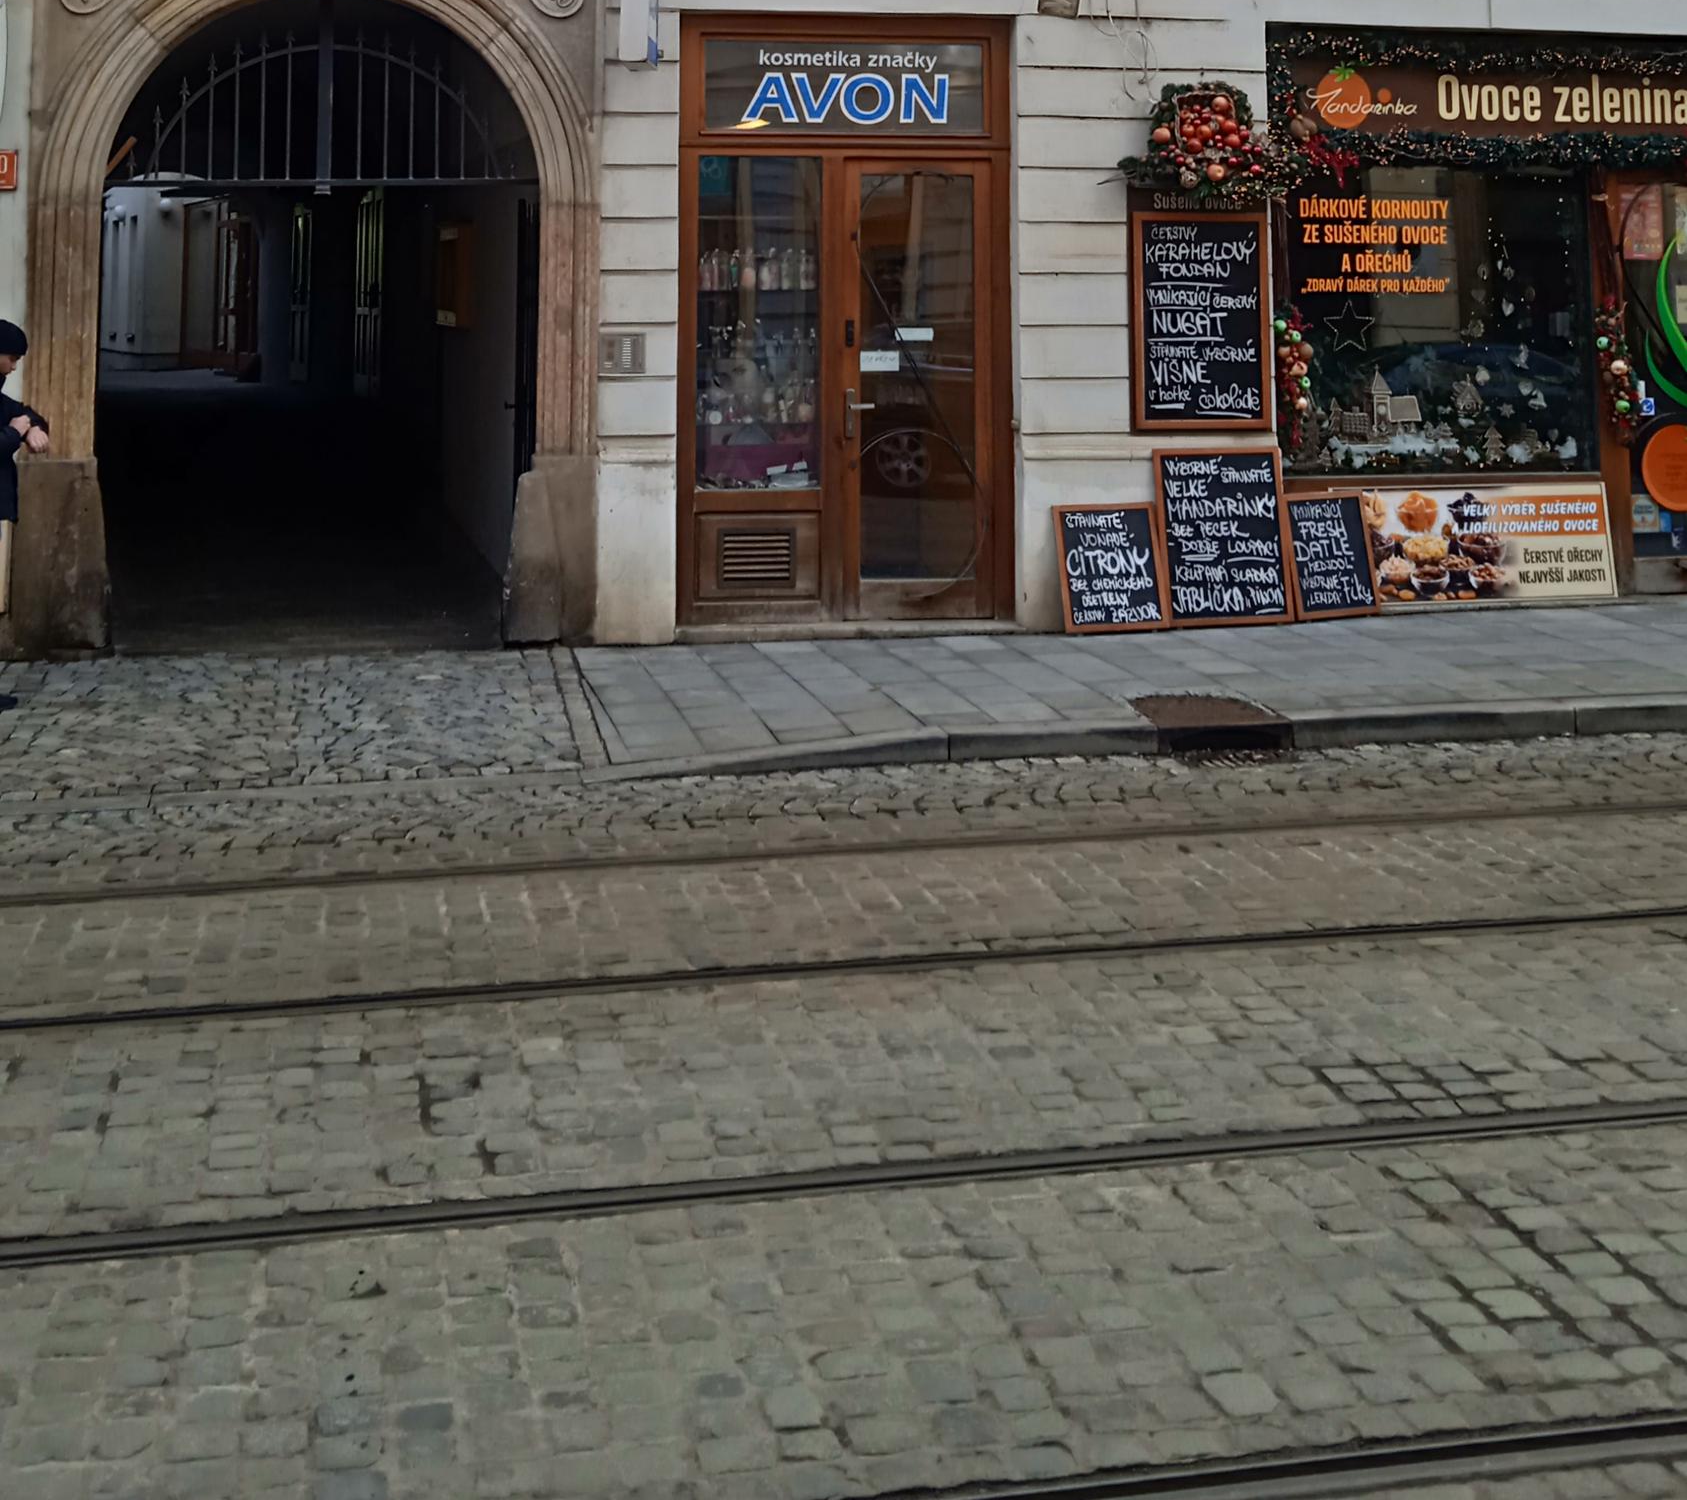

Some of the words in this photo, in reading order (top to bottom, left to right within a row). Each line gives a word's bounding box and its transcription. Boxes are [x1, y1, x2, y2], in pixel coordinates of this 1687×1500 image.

[758, 49, 861, 68] kosmetika
[867, 51, 938, 72] značky
[741, 72, 949, 125] AVON
[1437, 74, 1541, 122] Ovoce
[1553, 74, 1687, 125] zelenina
[1300, 194, 1367, 218] DÁRKOVÉ
[1371, 198, 1449, 220] KORNOUTY
[1303, 224, 1320, 244] ZE
[1324, 221, 1397, 245] SUŠENÉHO
[1402, 225, 1448, 245] OVOCE
[1341, 253, 1351, 272] A
[1355, 249, 1412, 273] OŘECHŮ
[1347, 276, 1378, 293] DÁREK
[1381, 278, 1400, 293] PRO
[1463, 501, 1497, 517] VELKÝ
[1501, 501, 1536, 516] VÝBĚR
[1539, 500, 1597, 515] SUŠENÉHO
[1298, 519, 1348, 540] FRESH
[1463, 518, 1559, 534] LIOFILIZOVANÉHO
[1564, 519, 1599, 532] OVOCE
[1293, 537, 1354, 562] DATLE
[1523, 547, 1565, 564] ČERSTVÉ
[1567, 547, 1604, 563] OŘECHY
[1519, 568, 1564, 584] NEJVYŠŠÍ
[1567, 569, 1606, 583] JAKOSTI
